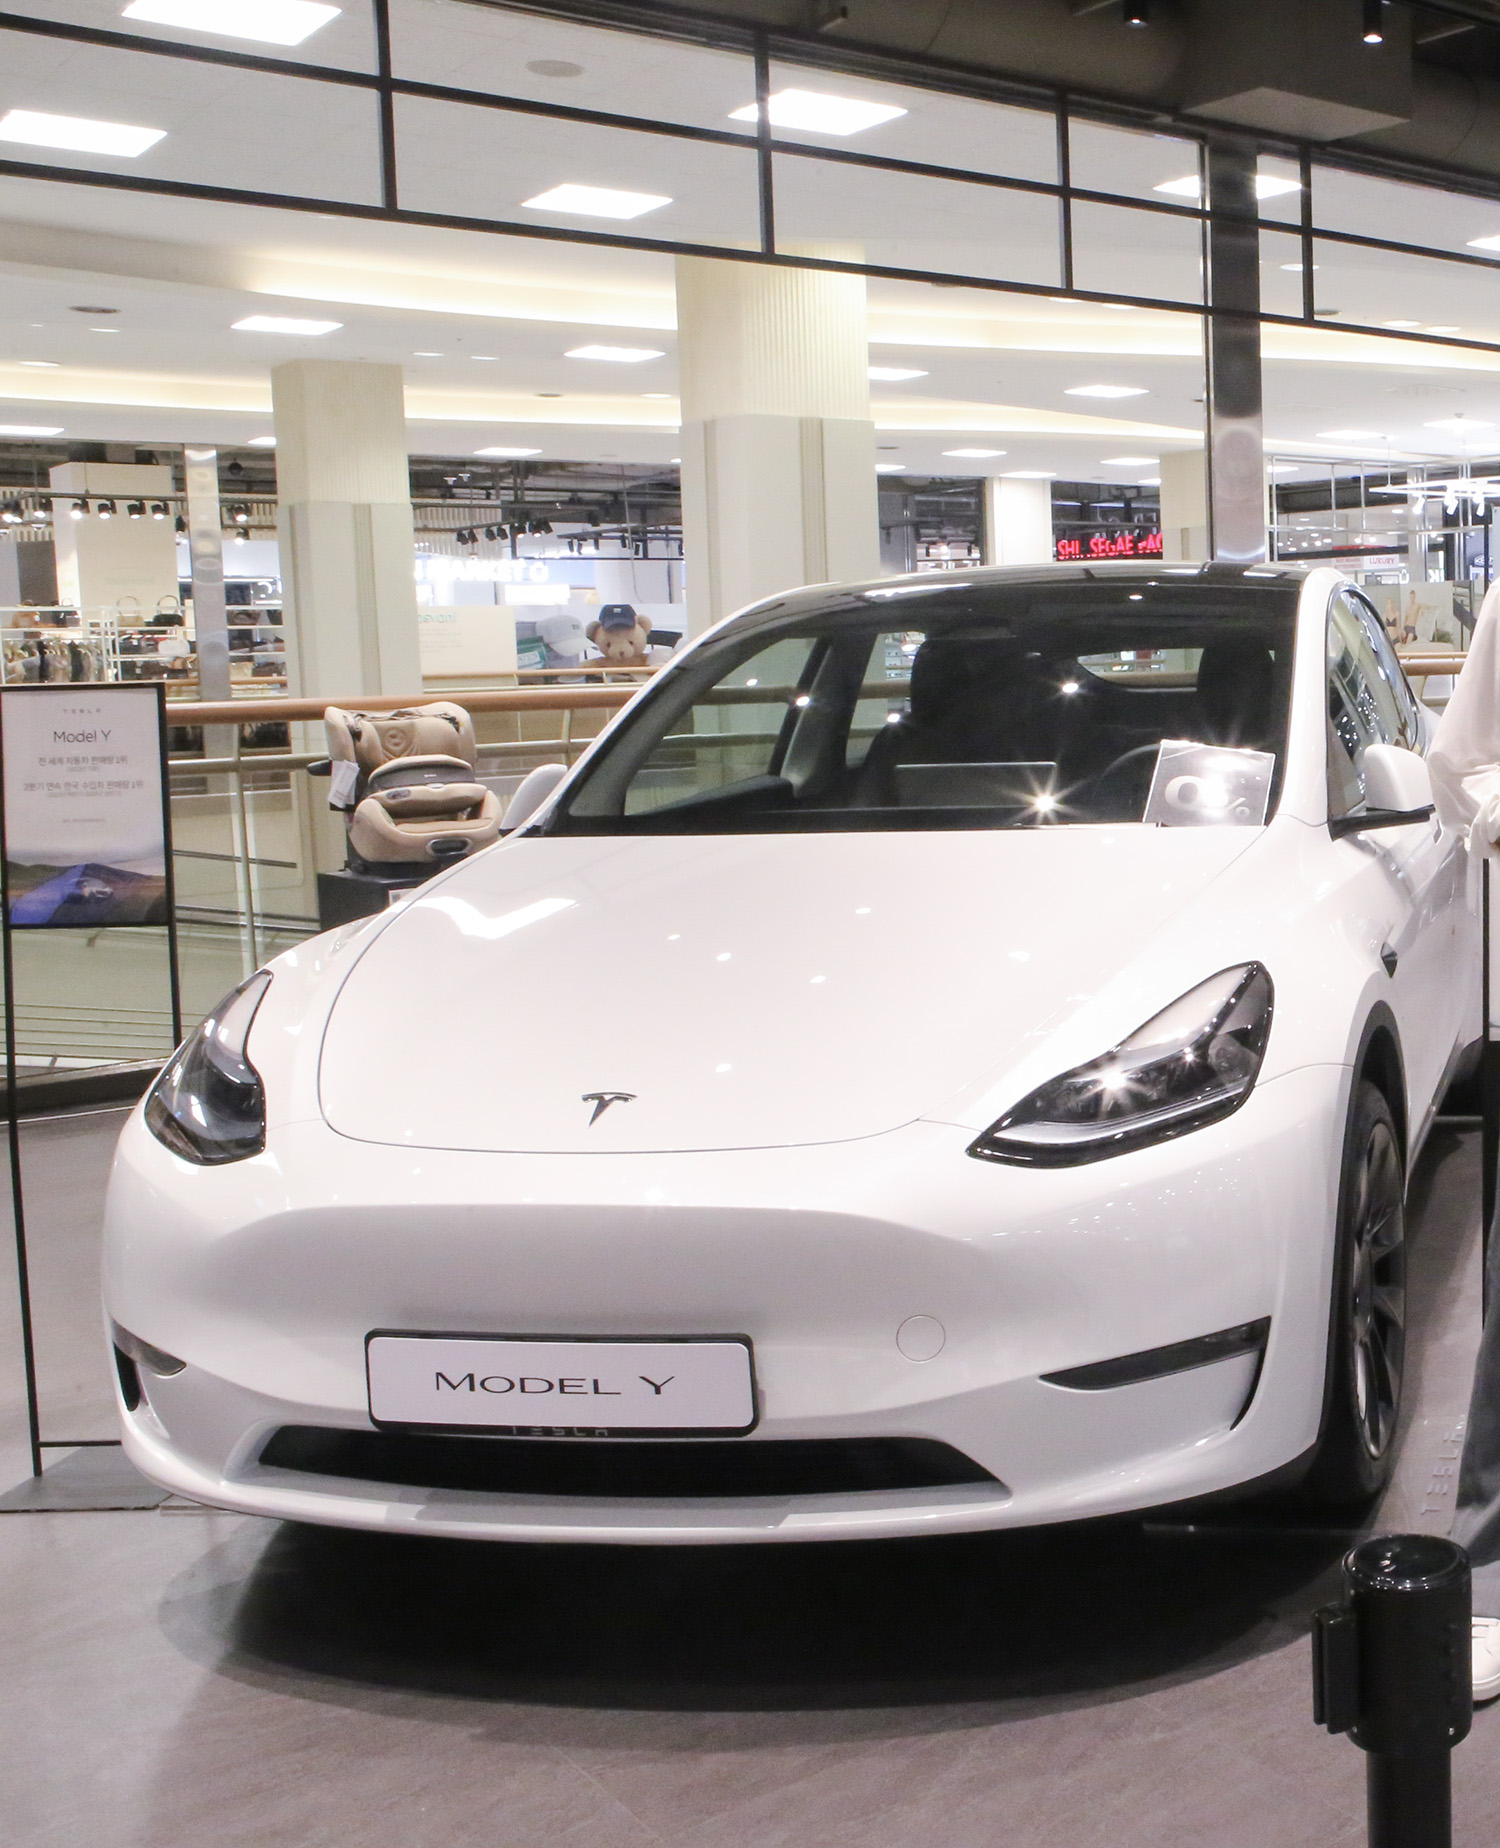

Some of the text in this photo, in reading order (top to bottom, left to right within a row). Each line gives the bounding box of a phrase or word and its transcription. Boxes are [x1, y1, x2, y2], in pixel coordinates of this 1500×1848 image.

[53, 729, 112, 743] Model Y
[434, 1371, 675, 1396] MODEL Y
